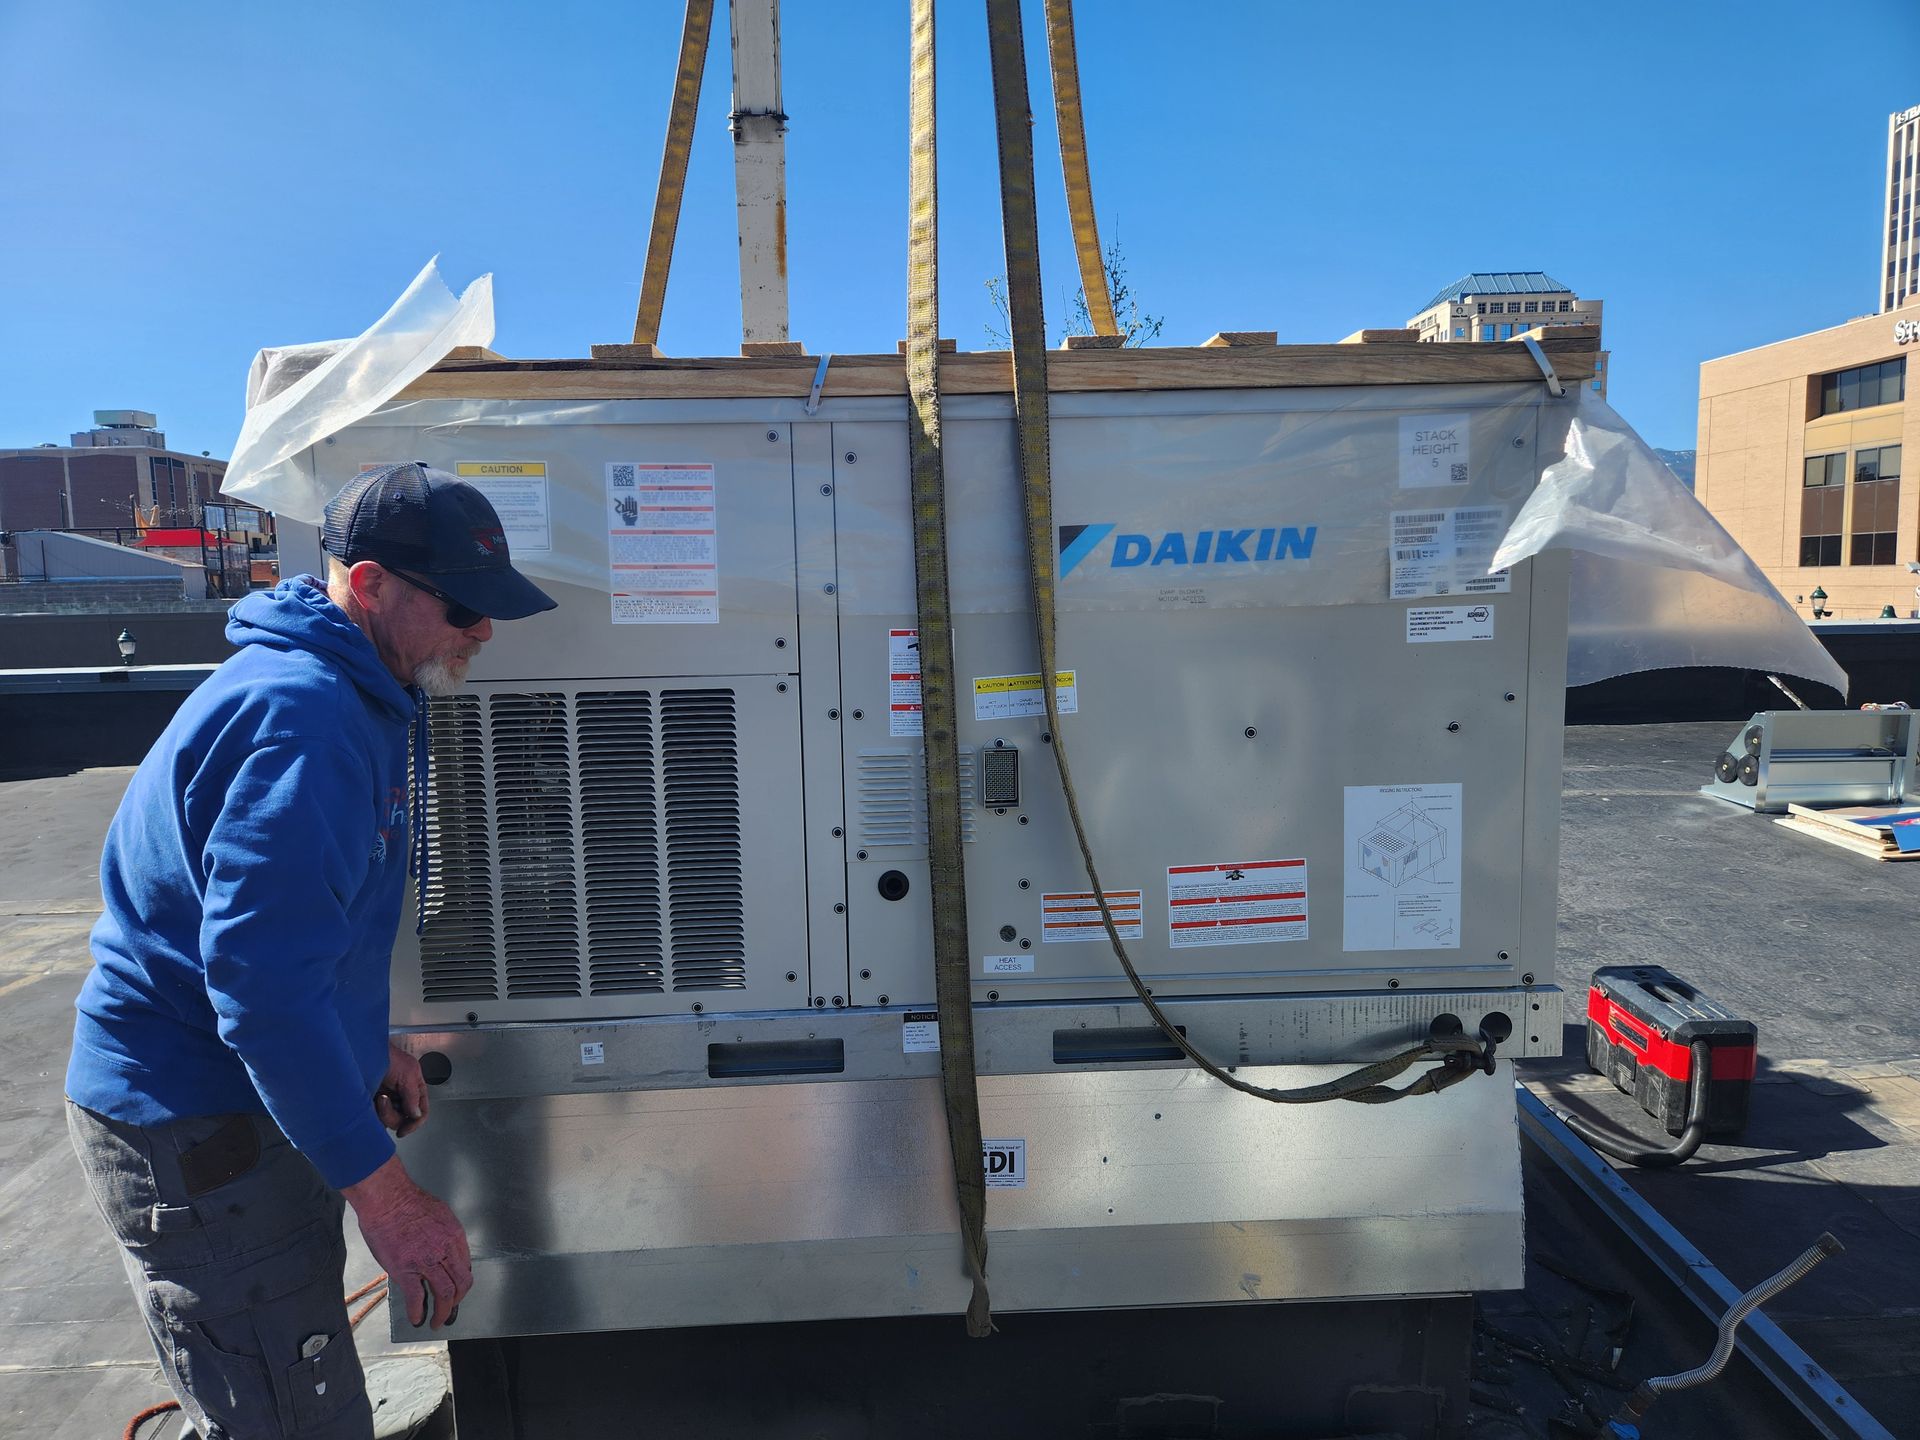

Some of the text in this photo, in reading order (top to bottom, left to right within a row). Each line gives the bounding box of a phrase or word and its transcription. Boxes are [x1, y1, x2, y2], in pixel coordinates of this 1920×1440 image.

[1415, 429, 1456, 442] STACK
[1412, 443, 1459, 455] HEIGHT
[1431, 458, 1439, 468] 5
[480, 465, 523, 474] CAUTION
[1110, 526, 1318, 568] DAIKIN
[911, 1013, 936, 1021] NOTICE
